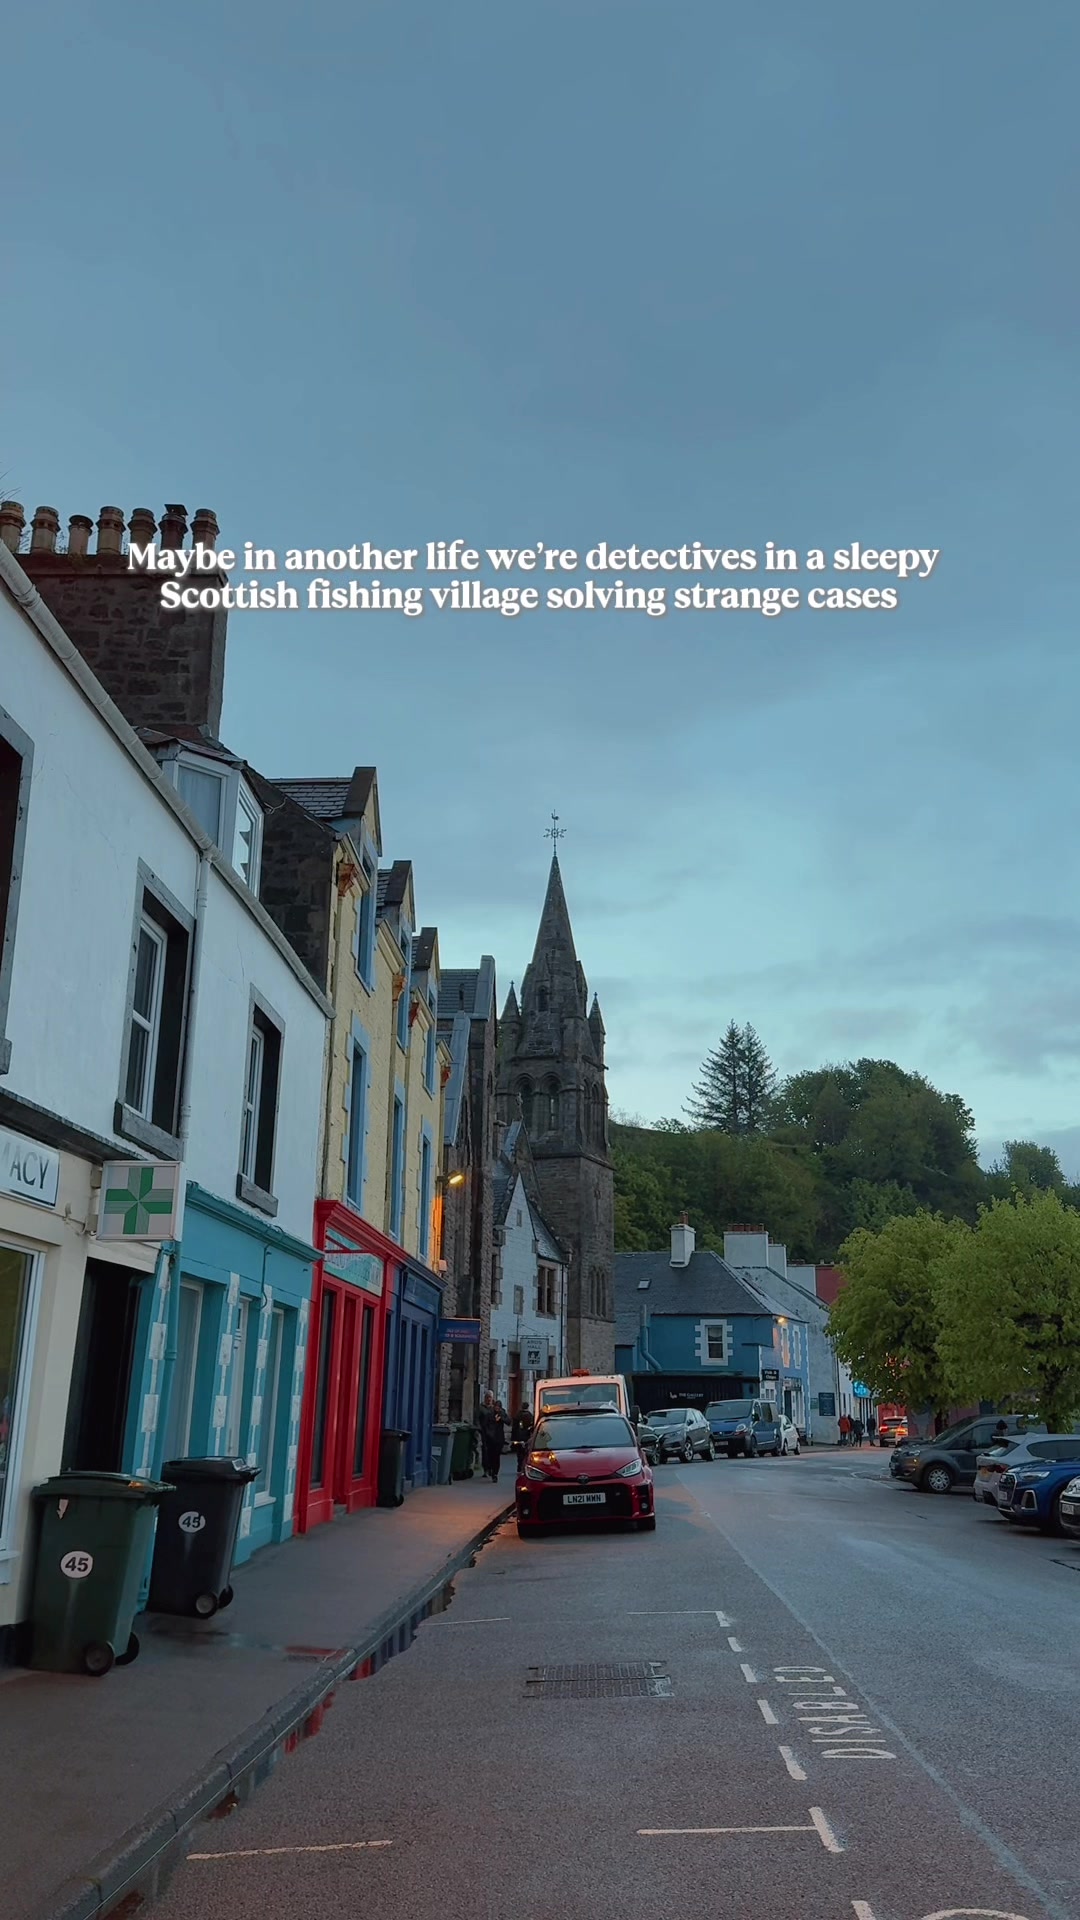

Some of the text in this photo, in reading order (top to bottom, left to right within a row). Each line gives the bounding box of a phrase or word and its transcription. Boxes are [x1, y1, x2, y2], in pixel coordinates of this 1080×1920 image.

[567, 1495, 585, 1504] LN21
[181, 1515, 201, 1529] 45
[65, 1556, 89, 1572] 45
[772, 1665, 898, 1759] DISABLED
